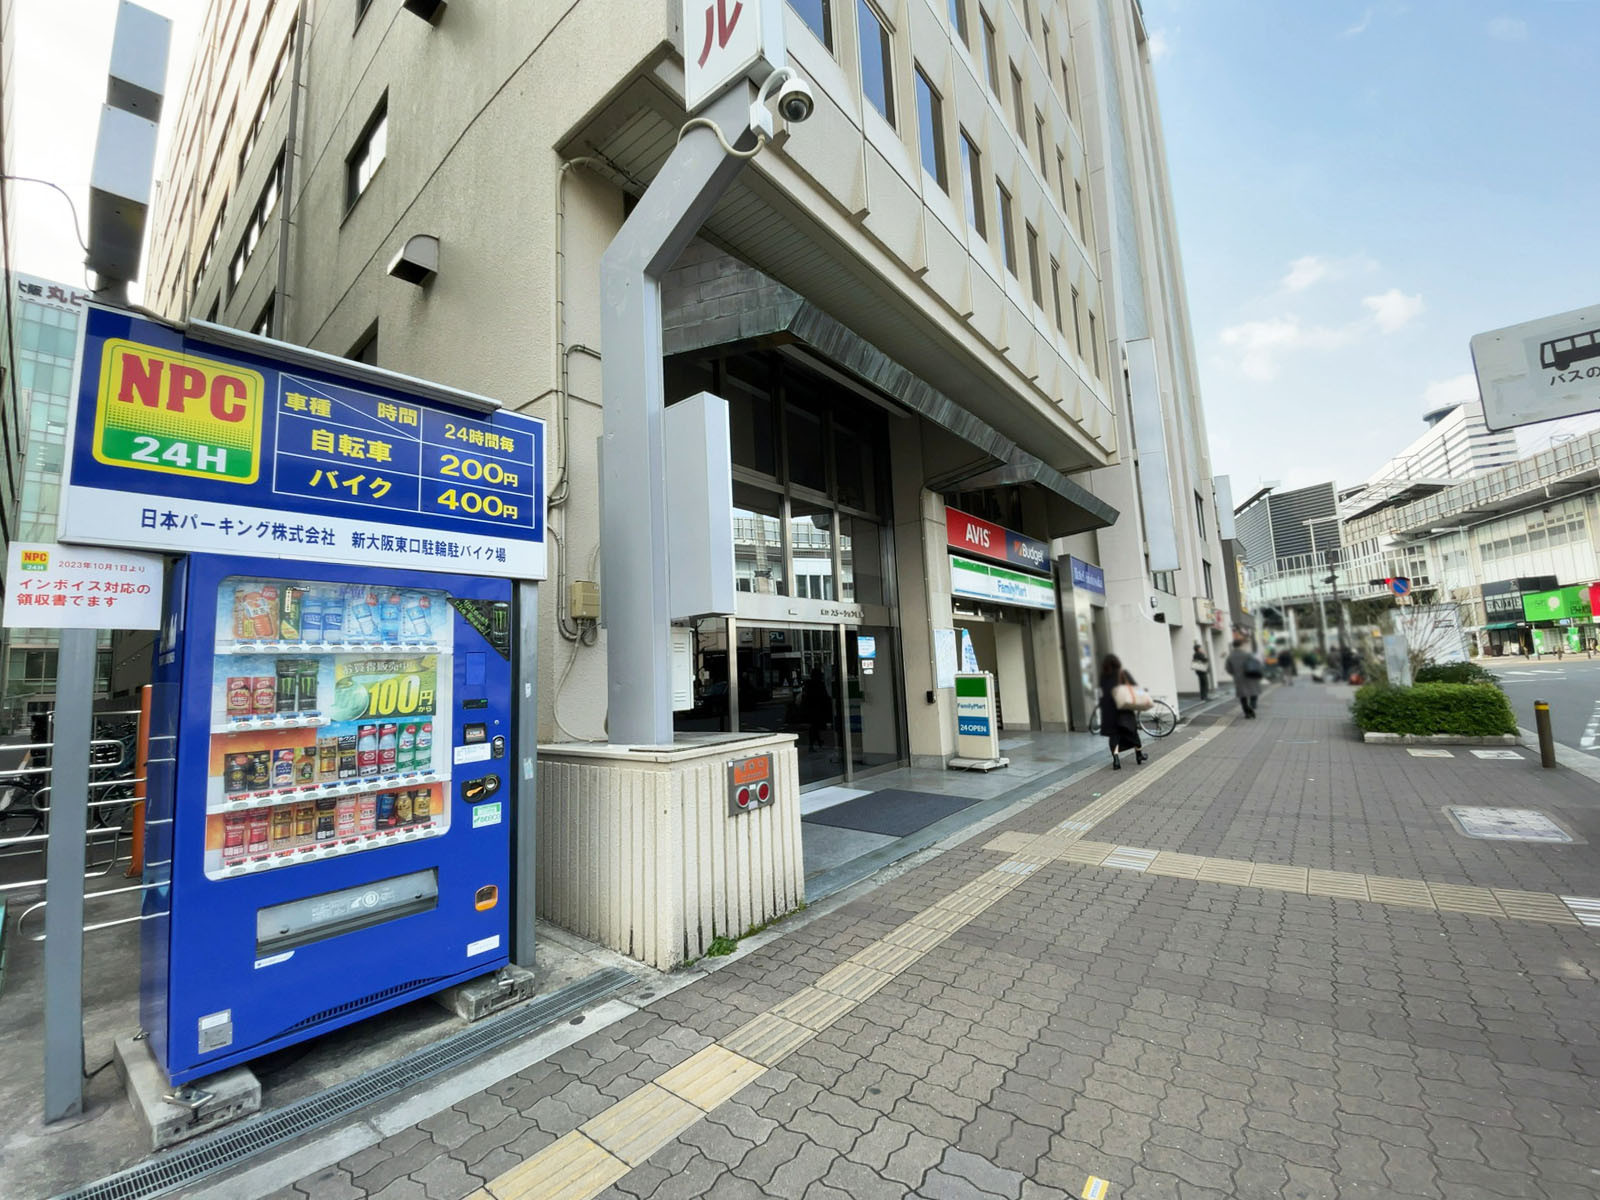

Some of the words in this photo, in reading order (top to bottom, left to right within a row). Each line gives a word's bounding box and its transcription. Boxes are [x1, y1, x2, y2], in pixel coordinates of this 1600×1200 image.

[117, 352, 248, 423] NPC
[284, 391, 332, 418] 車種
[377, 401, 418, 427] 時間
[311, 429, 393, 462] 自転車
[444, 423, 515, 453] 24時間毎
[131, 435, 227, 473] 24H
[308, 469, 393, 499] バイク
[439, 454, 519, 488] 200円
[437, 488, 519, 519] 400円
[141, 507, 336, 546] 日本パーキング株式会社
[351, 531, 507, 563] 新大阪東口駐輪駐バイク場
[965, 522, 991, 548] AVIS
[24, 551, 47, 562] NPC
[58, 560, 146, 573] 2023年10月1日より
[1021, 543, 1044, 565] Budget
[16, 592, 118, 607] 領収書でます
[19, 578, 151, 594] インボイス対応の
[997, 580, 1028, 597] FamilyMart
[368, 674, 433, 715] 100円
